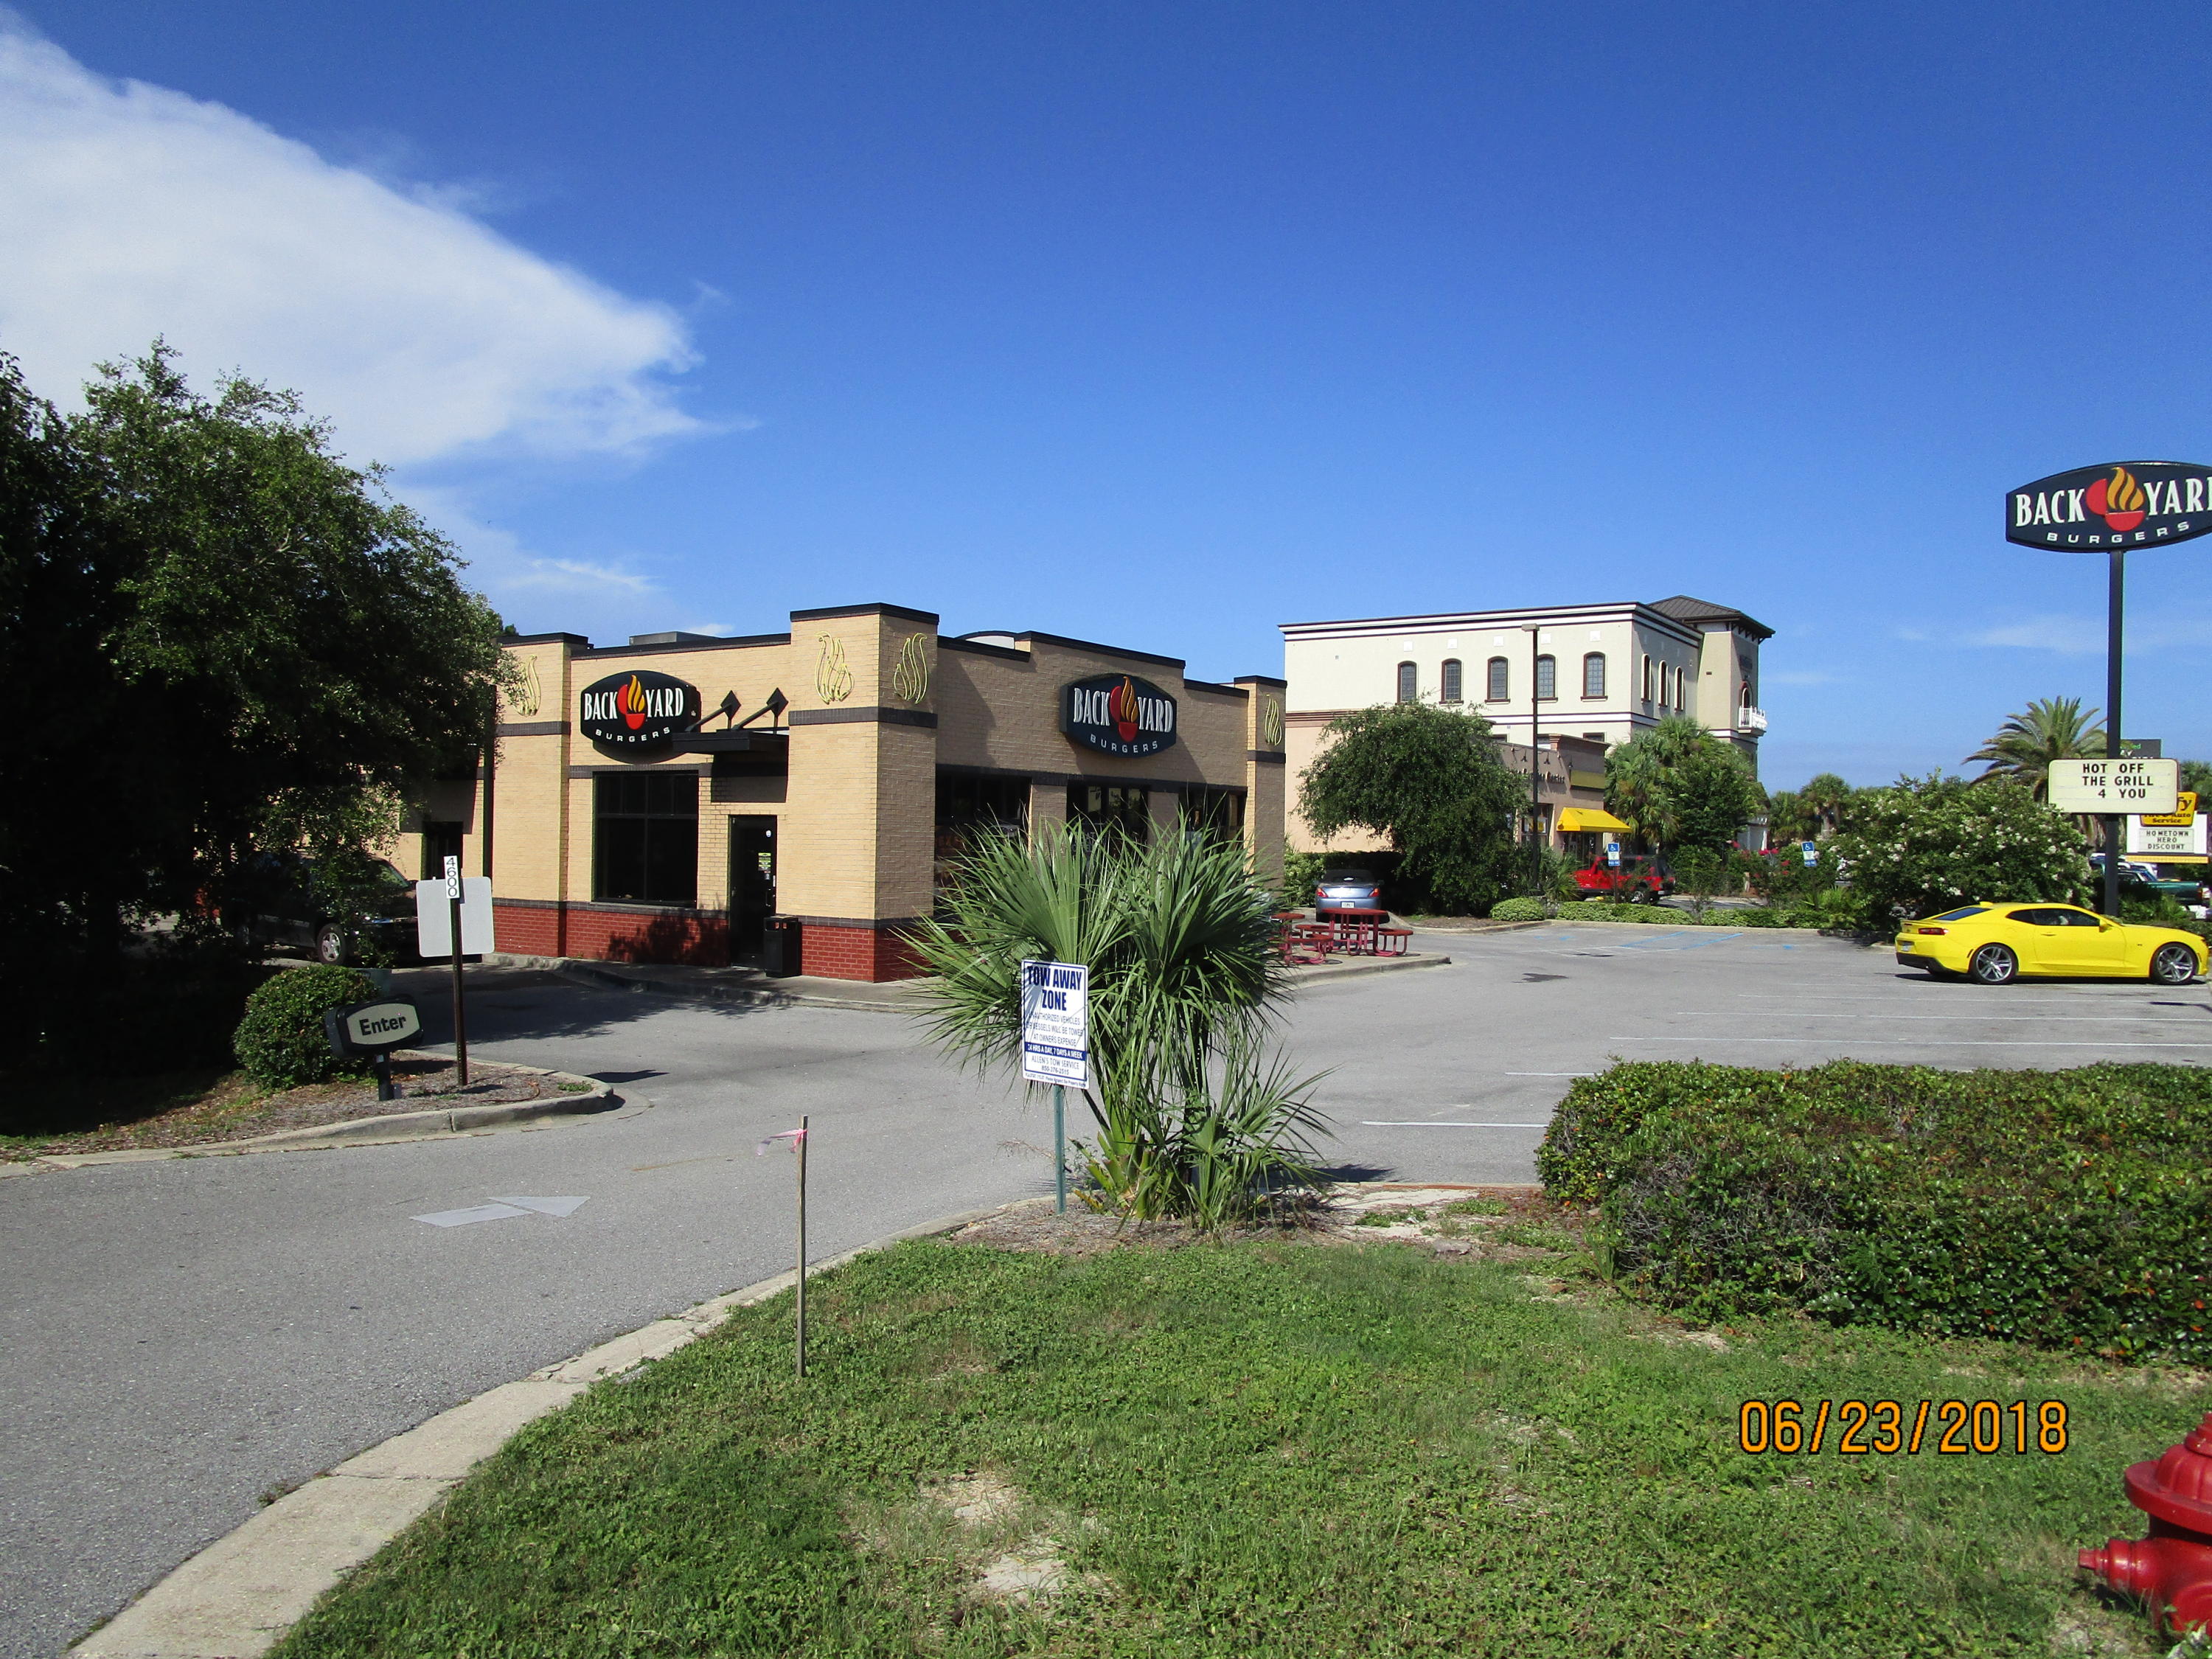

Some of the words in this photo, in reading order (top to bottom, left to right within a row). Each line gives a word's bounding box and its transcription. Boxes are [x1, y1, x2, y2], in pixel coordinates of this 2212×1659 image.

[2016, 488, 2086, 526] BACK
[2143, 476, 2212, 516] YAR
[2047, 521, 2189, 543] BURGERS
[584, 691, 619, 720] BACK
[645, 687, 684, 718] YARD
[1074, 687, 1110, 726] BACK
[1137, 696, 1174, 733] YARD
[595, 726, 670, 742] BURGERS
[1090, 734, 1158, 753] BURGERS
[2082, 763, 2108, 773] HOT
[2118, 763, 2144, 773] OFF
[2082, 776, 2106, 786] THE
[2114, 776, 2154, 786] GRILL
[2098, 788, 2106, 798] 4
[2119, 788, 2146, 799] YOU
[446, 857, 457, 897] 4600
[1027, 965, 1051, 987] TOW
[1053, 969, 1082, 990] AWAY
[1042, 989, 1067, 1011] ZONE
[359, 1016, 406, 1036] Enter
[1061, 1015, 1080, 1025] VEHICLES
[1032, 1022, 1051, 1032] VESSELS
[1051, 1025, 1062, 1034] WILL
[1062, 1026, 1068, 1034] BE
[1068, 1027, 1083, 1037] TOWED
[1057, 1037, 1077, 1047] EXPENSE
[1032, 1044, 1040, 1052] HRS
[1056, 1048, 1067, 1057] DAYS
[1068, 1049, 1071, 1057] A
[1071, 1051, 1083, 1060] WEEK
[1032, 1055, 1049, 1064] ALLEN'S
[1050, 1057, 1061, 1066] TOW
[1061, 1060, 1080, 1070] SERVICE
